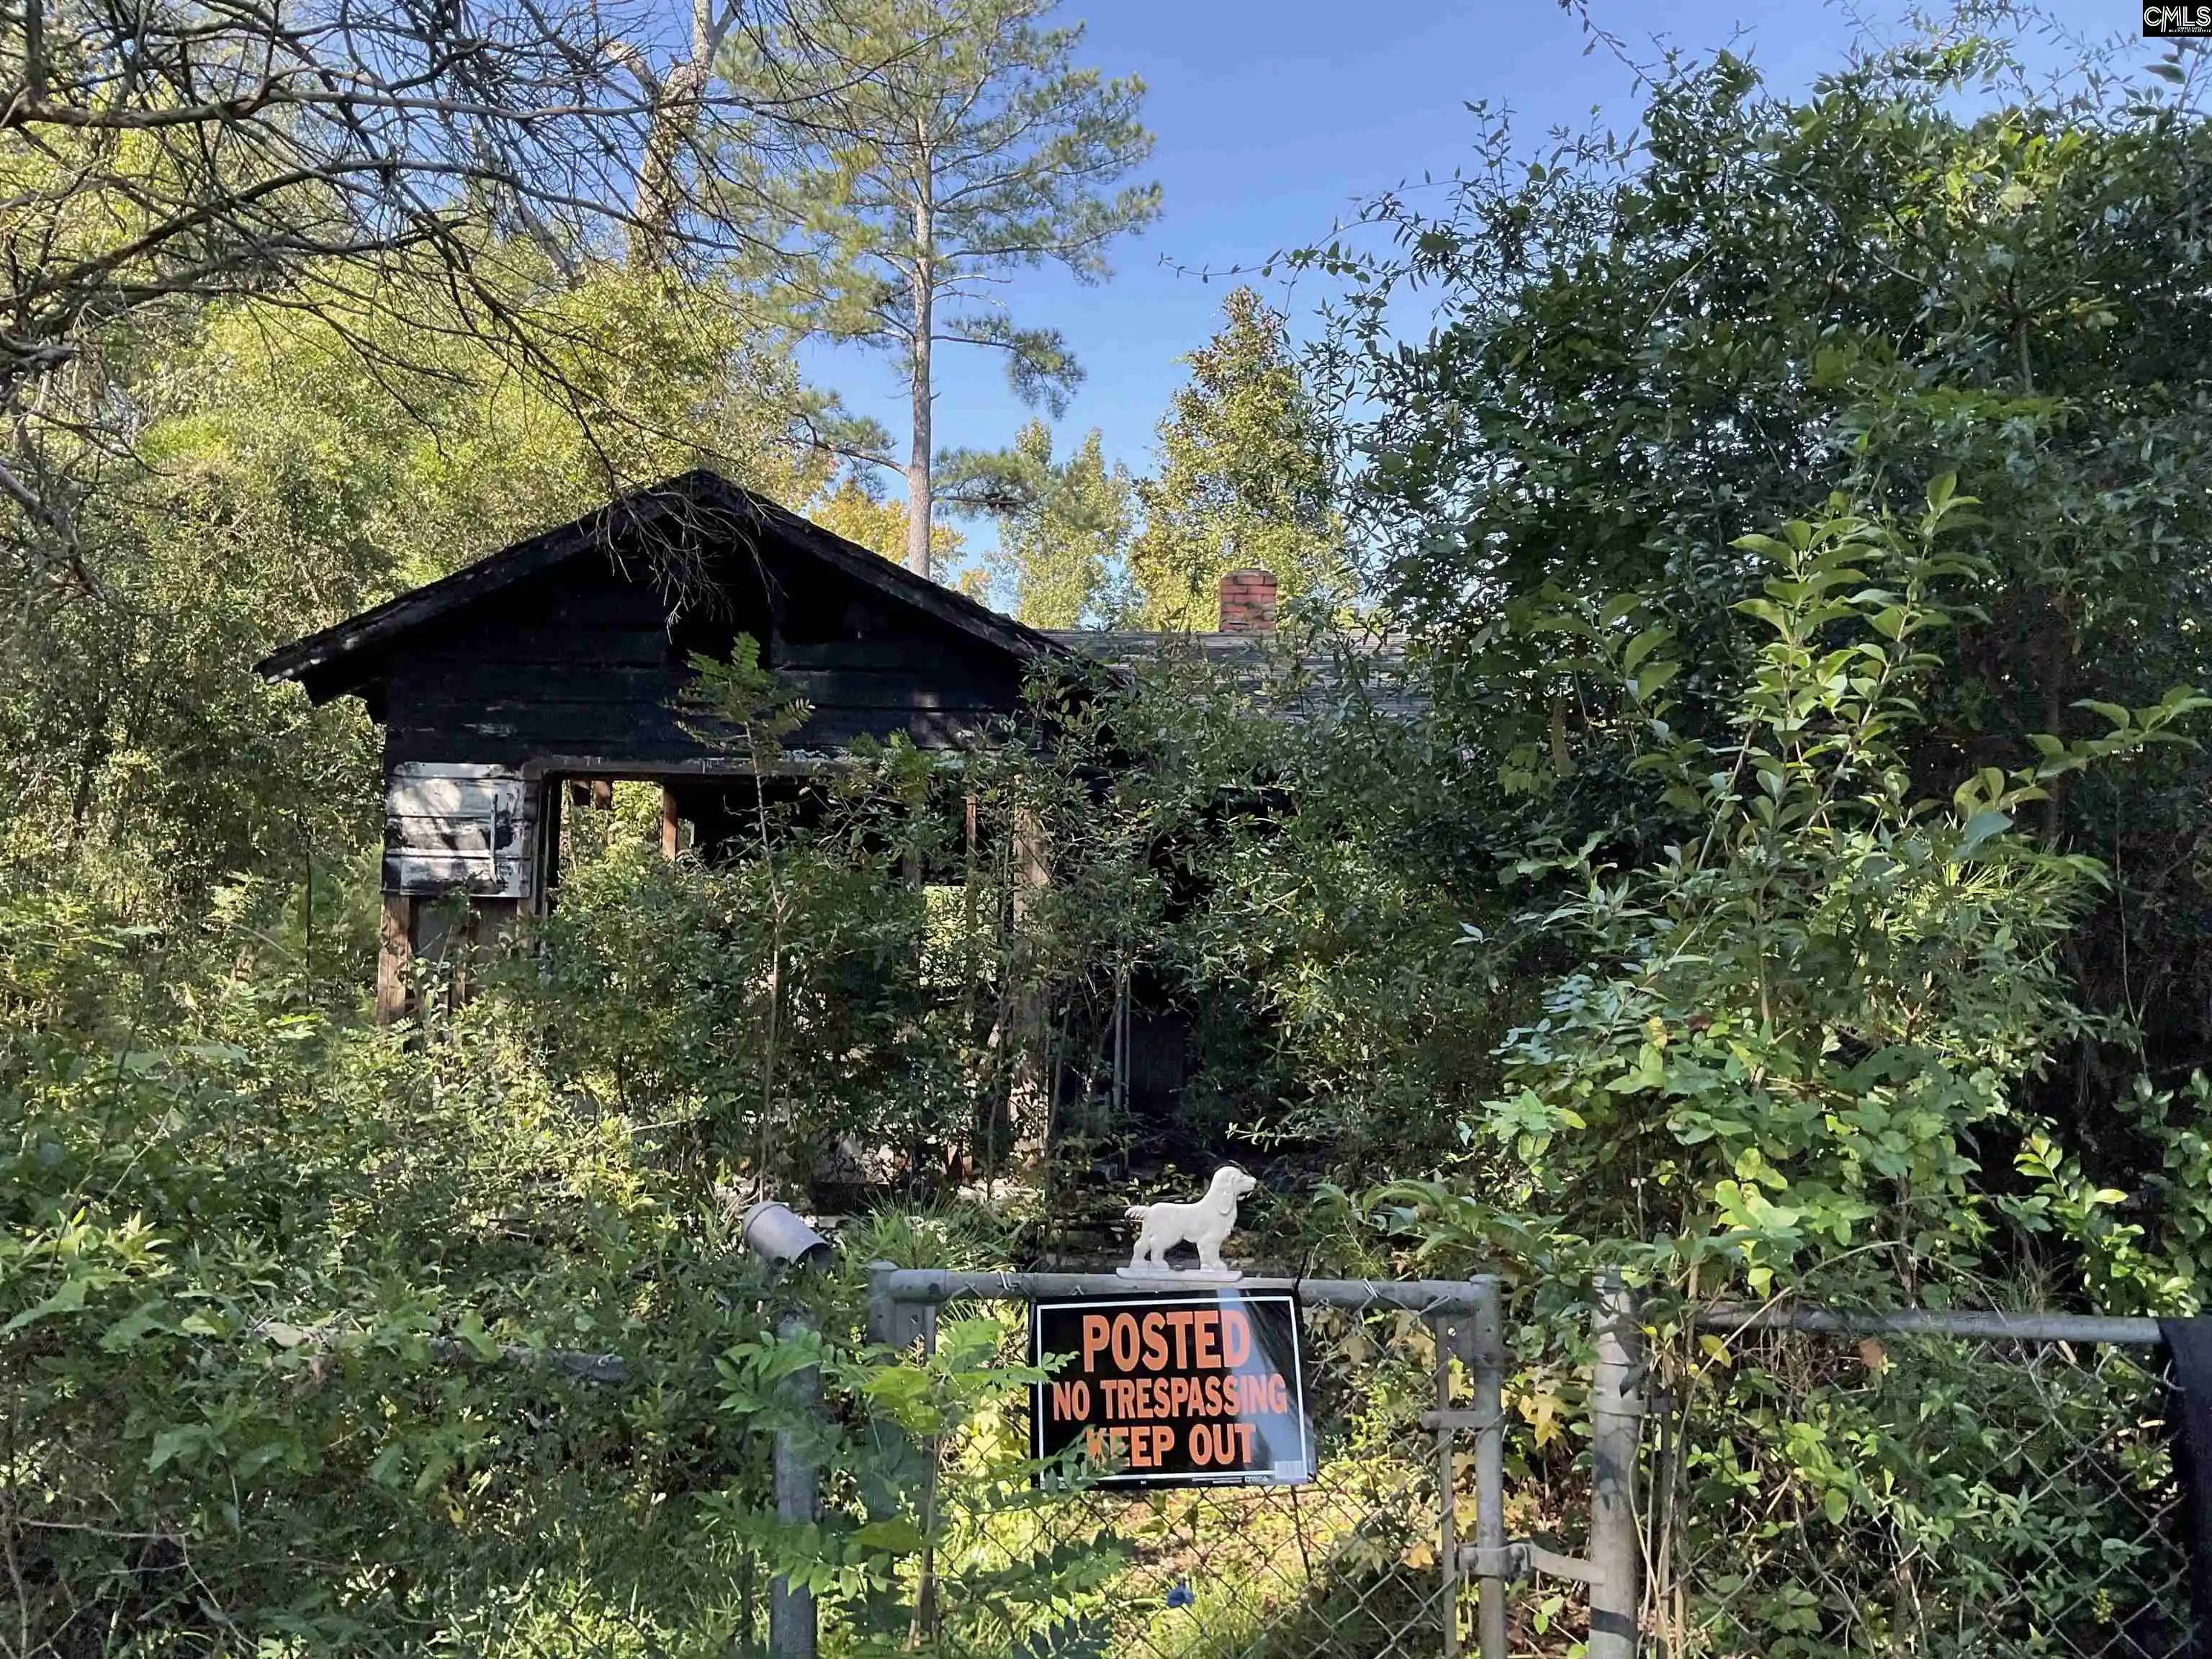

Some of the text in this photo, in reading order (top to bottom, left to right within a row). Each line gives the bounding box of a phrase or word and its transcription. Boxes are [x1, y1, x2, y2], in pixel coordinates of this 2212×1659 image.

[1083, 1310, 1251, 1372] POSTED
[1053, 1373, 1288, 1421] NO TRESPASSING
[1188, 1423, 1256, 1465] OUT
